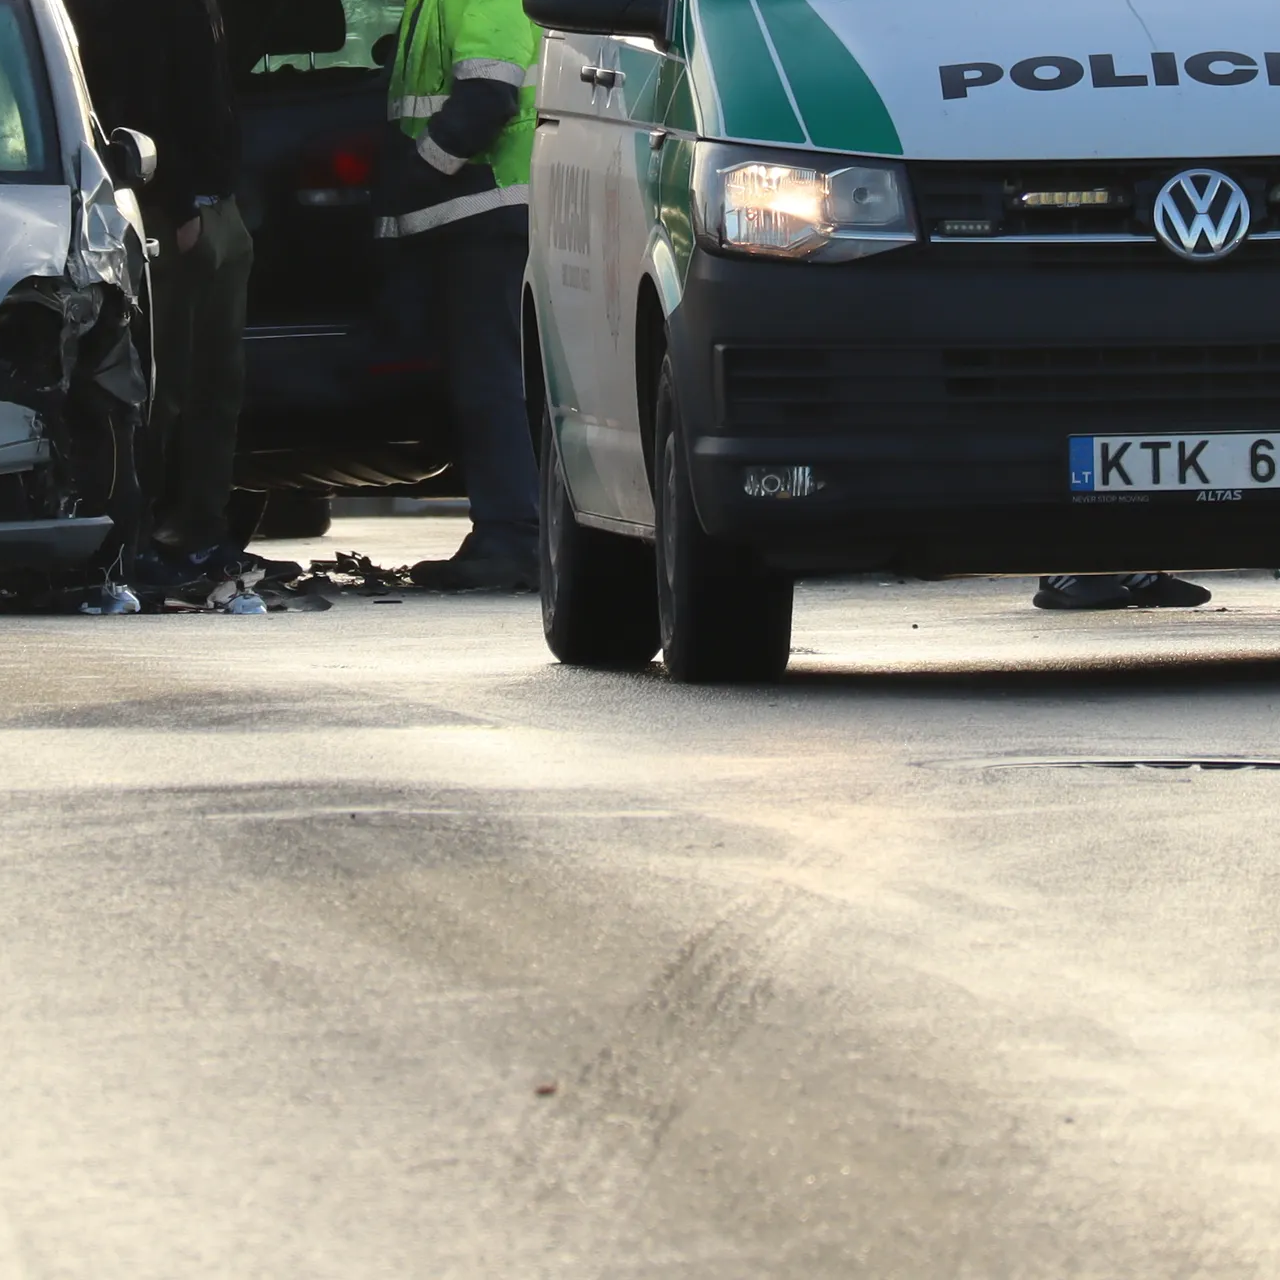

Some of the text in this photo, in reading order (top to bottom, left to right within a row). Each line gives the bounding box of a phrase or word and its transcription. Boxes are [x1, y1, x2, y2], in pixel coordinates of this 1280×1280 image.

[1100, 439, 1210, 486] KTK
[1071, 471, 1091, 483] LT
[1196, 489, 1243, 502] ALTAS
